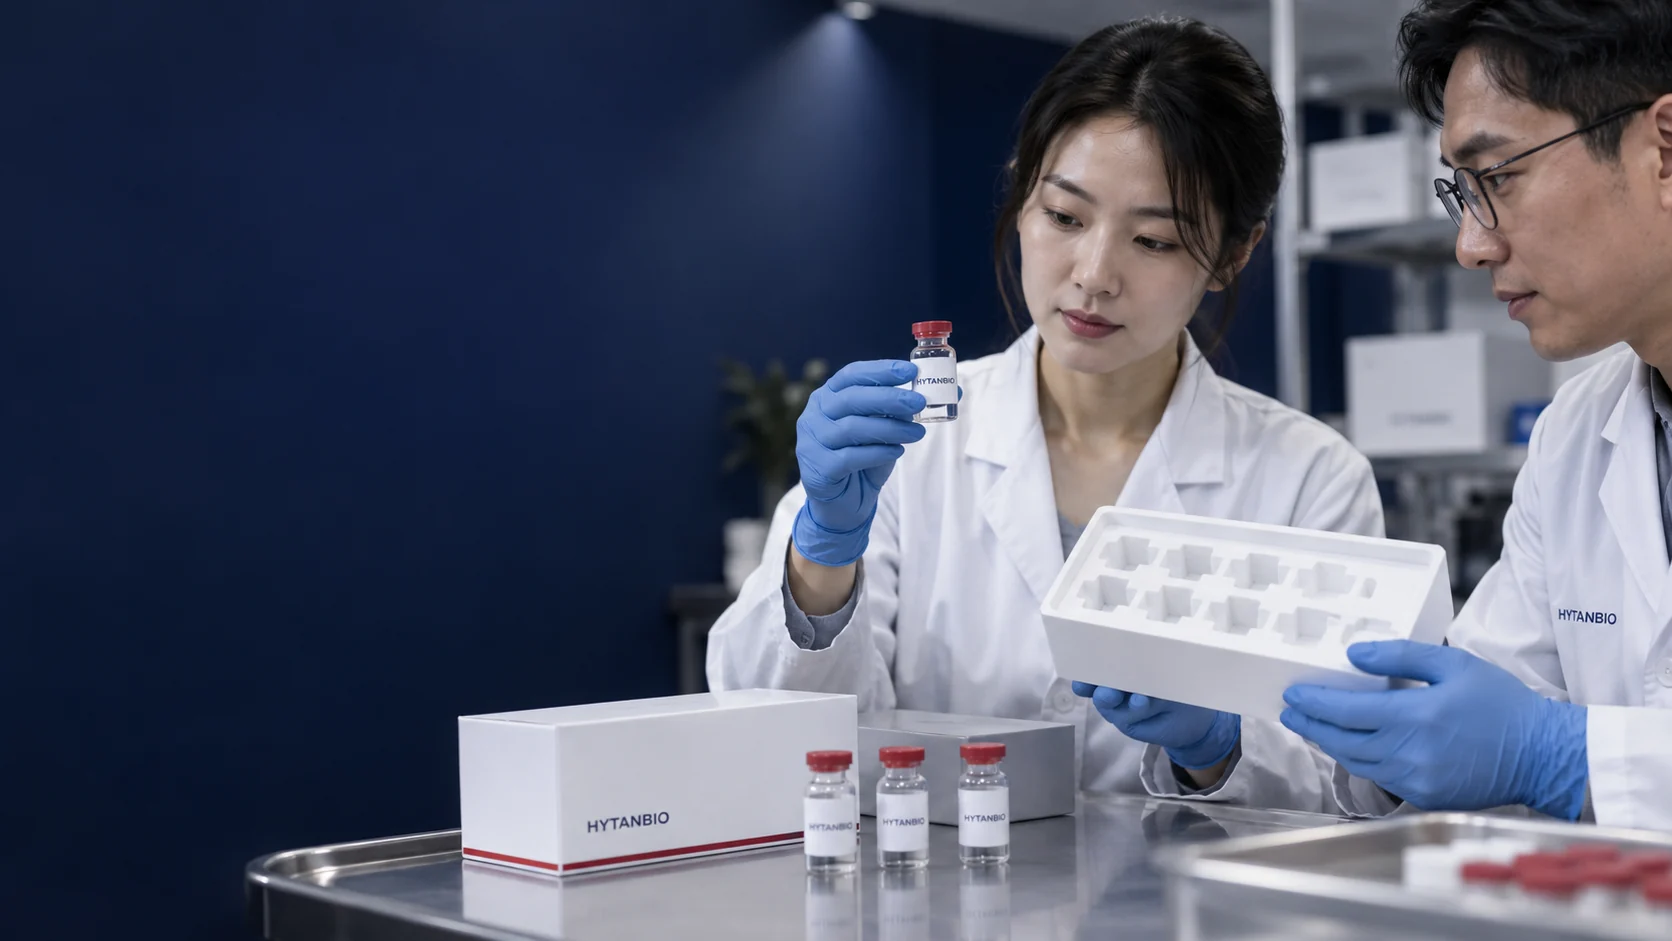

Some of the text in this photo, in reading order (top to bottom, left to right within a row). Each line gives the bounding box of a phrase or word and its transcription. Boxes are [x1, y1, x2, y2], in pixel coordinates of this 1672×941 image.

[916, 377, 956, 385] HYTANBIO
[1558, 608, 1617, 625] HYTANBIO
[587, 811, 670, 833] HYTANBIO
[882, 817, 926, 827] HYTANBIO
[964, 813, 1006, 822] HYTANBIO
[809, 822, 853, 832] HYTANBIO
